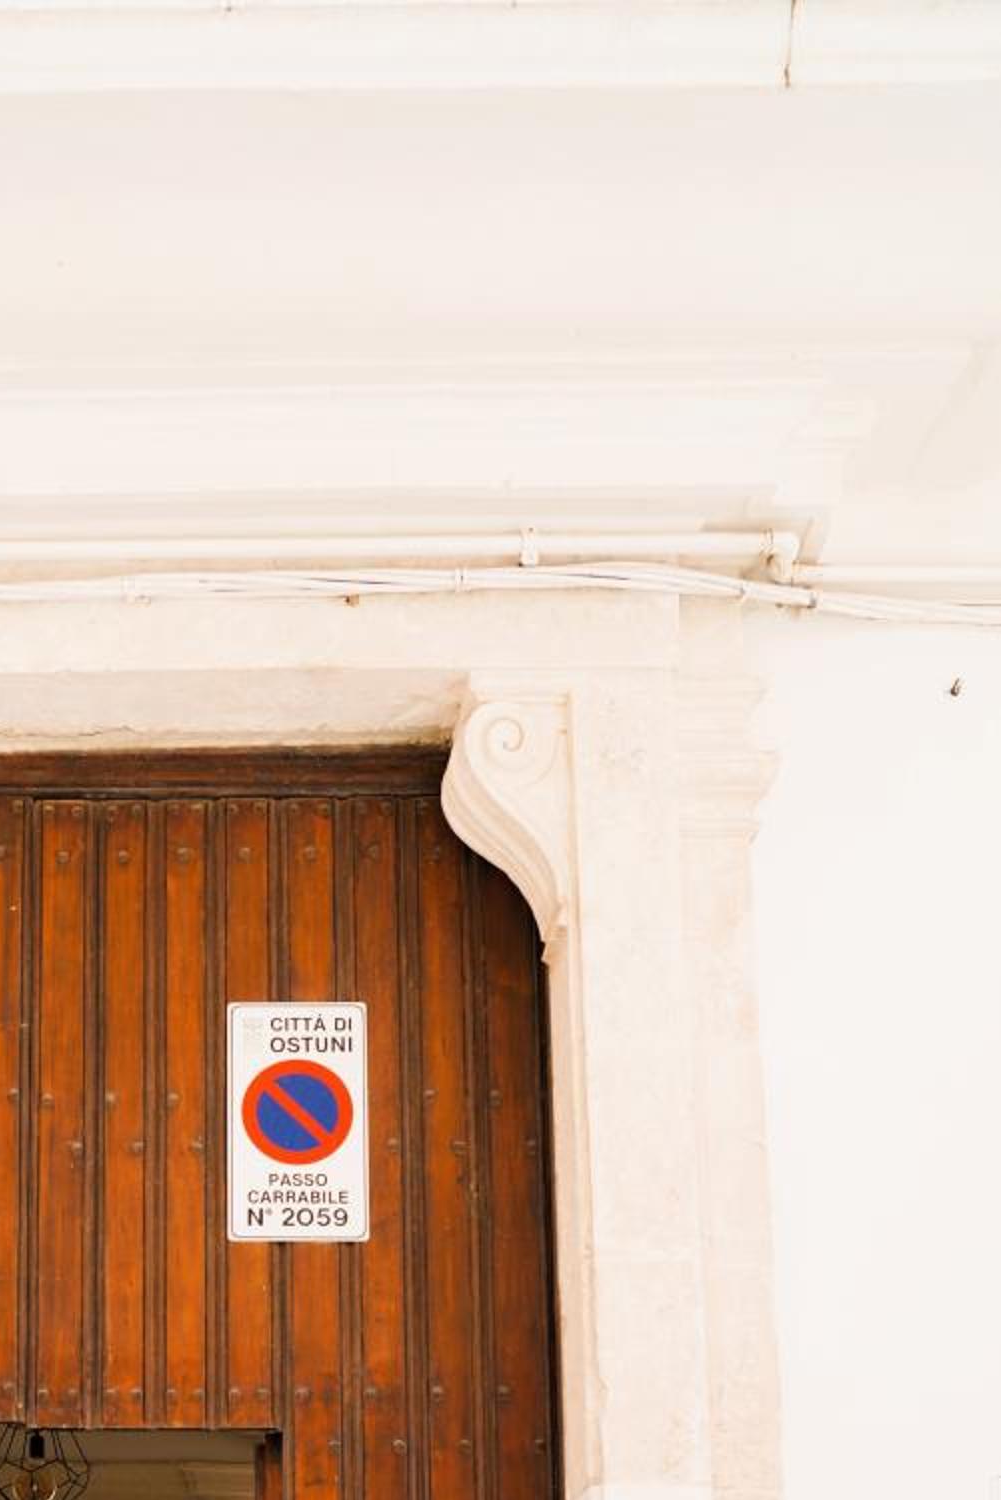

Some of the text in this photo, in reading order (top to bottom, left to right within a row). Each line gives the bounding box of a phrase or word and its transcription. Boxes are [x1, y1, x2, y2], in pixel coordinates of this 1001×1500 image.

[334, 1017, 353, 1031] DI
[270, 1036, 353, 1053] OSTUNI
[268, 1173, 329, 1187] PASSO
[248, 1190, 349, 1204] CARRABILE
[282, 1207, 349, 1227] 2059
